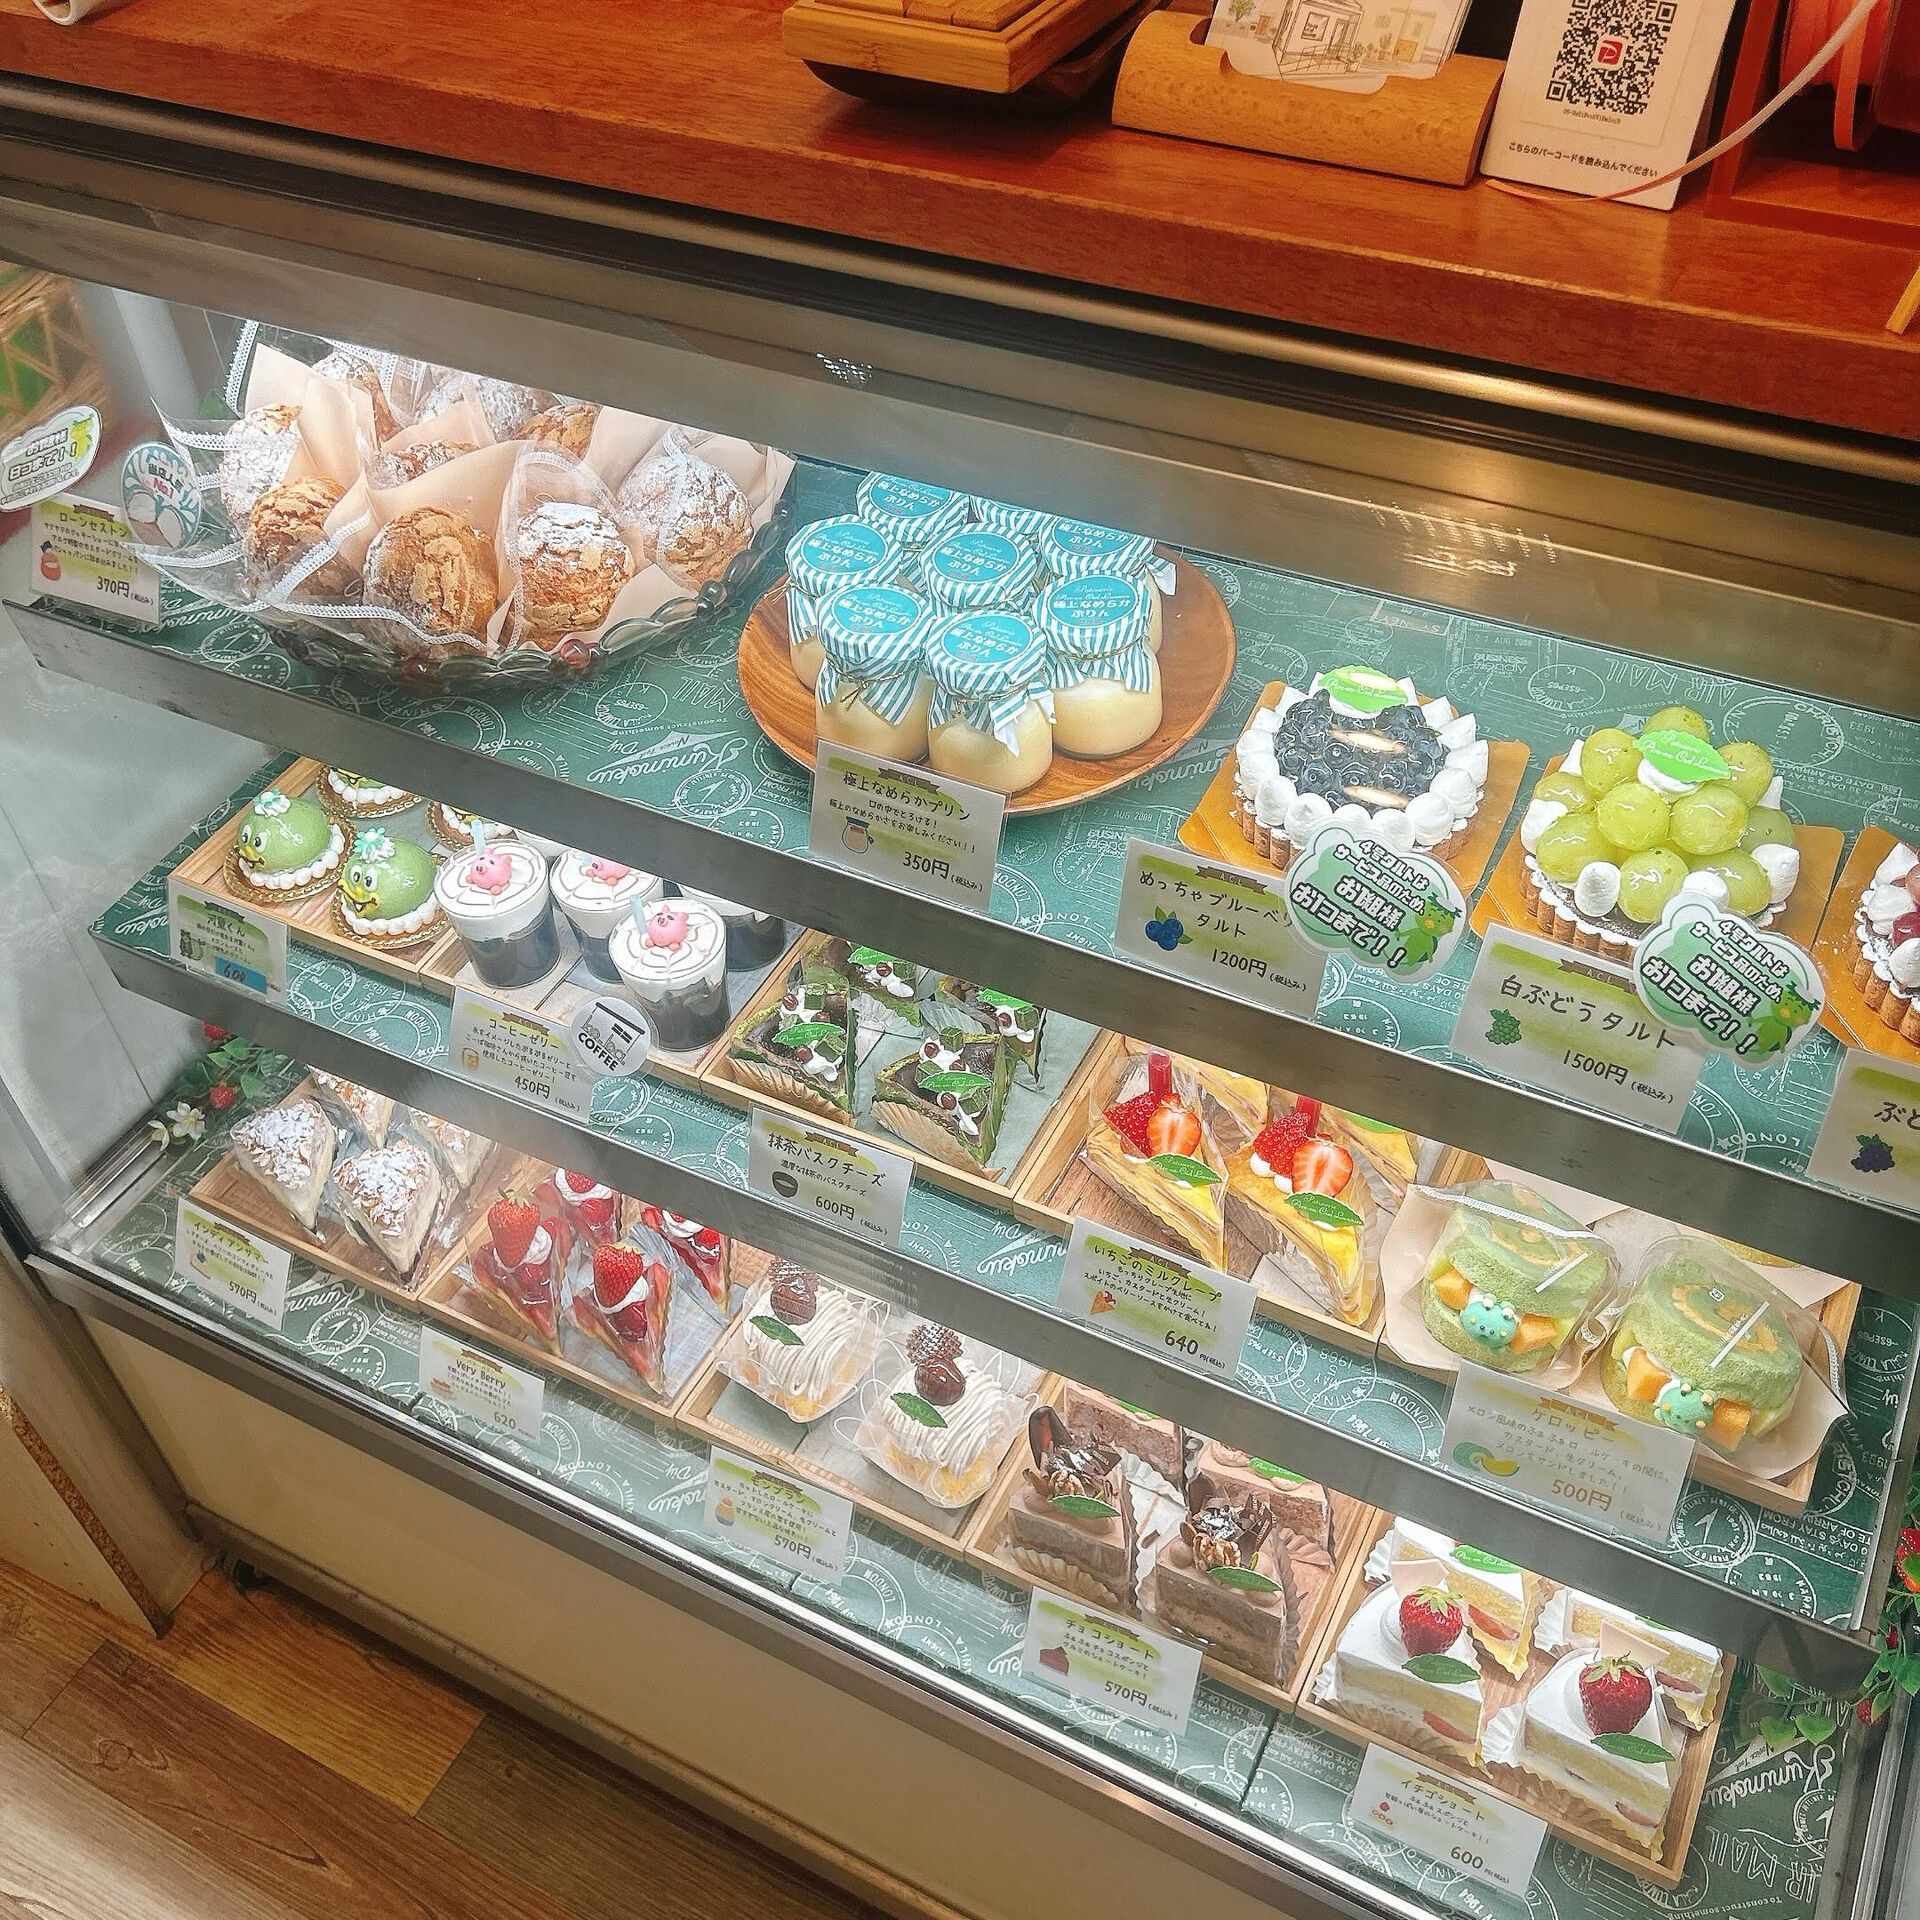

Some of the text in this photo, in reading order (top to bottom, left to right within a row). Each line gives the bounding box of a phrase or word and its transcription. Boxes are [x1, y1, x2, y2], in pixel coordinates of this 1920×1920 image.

[1508, 142, 1658, 177] こちらのバーコードを読み込んでください
[97, 576, 130, 598] 370円
[843, 770, 970, 821] 極上なめらかプリン
[902, 851, 950, 880] 350円
[1359, 840, 1430, 891] 4号タルトは
[1196, 912, 1247, 938] タルト
[1211, 946, 1268, 978] 1200円
[1719, 920, 1790, 979] 4号タルトは
[1499, 974, 1676, 1050] 白ぶどうタルト
[489, 1018, 560, 1050] コーヒーゼリー
[578, 1033, 619, 1072] COFFEE
[1562, 1048, 1629, 1086] 1500円
[514, 1075, 551, 1100] 450円
[767, 1132, 886, 1187] 抹茶バスクチーズ
[815, 1196, 856, 1221] 600円
[1094, 1244, 1222, 1302] いちごのミルクレープ
[229, 1280, 257, 1304] 570円
[1164, 1330, 1199, 1355] 640
[456, 1359, 506, 1389] Very Berry
[494, 1411, 516, 1430] 620
[1532, 1408, 1615, 1443] ケロッピー
[1551, 1479, 1613, 1512] 500円
[774, 1534, 812, 1560] 570円
[1065, 1619, 1155, 1661] チョコショート
[1103, 1680, 1148, 1707] 570円
[1401, 1780, 1486, 1821] イチゴショート
[1450, 1846, 1484, 1869] 600
